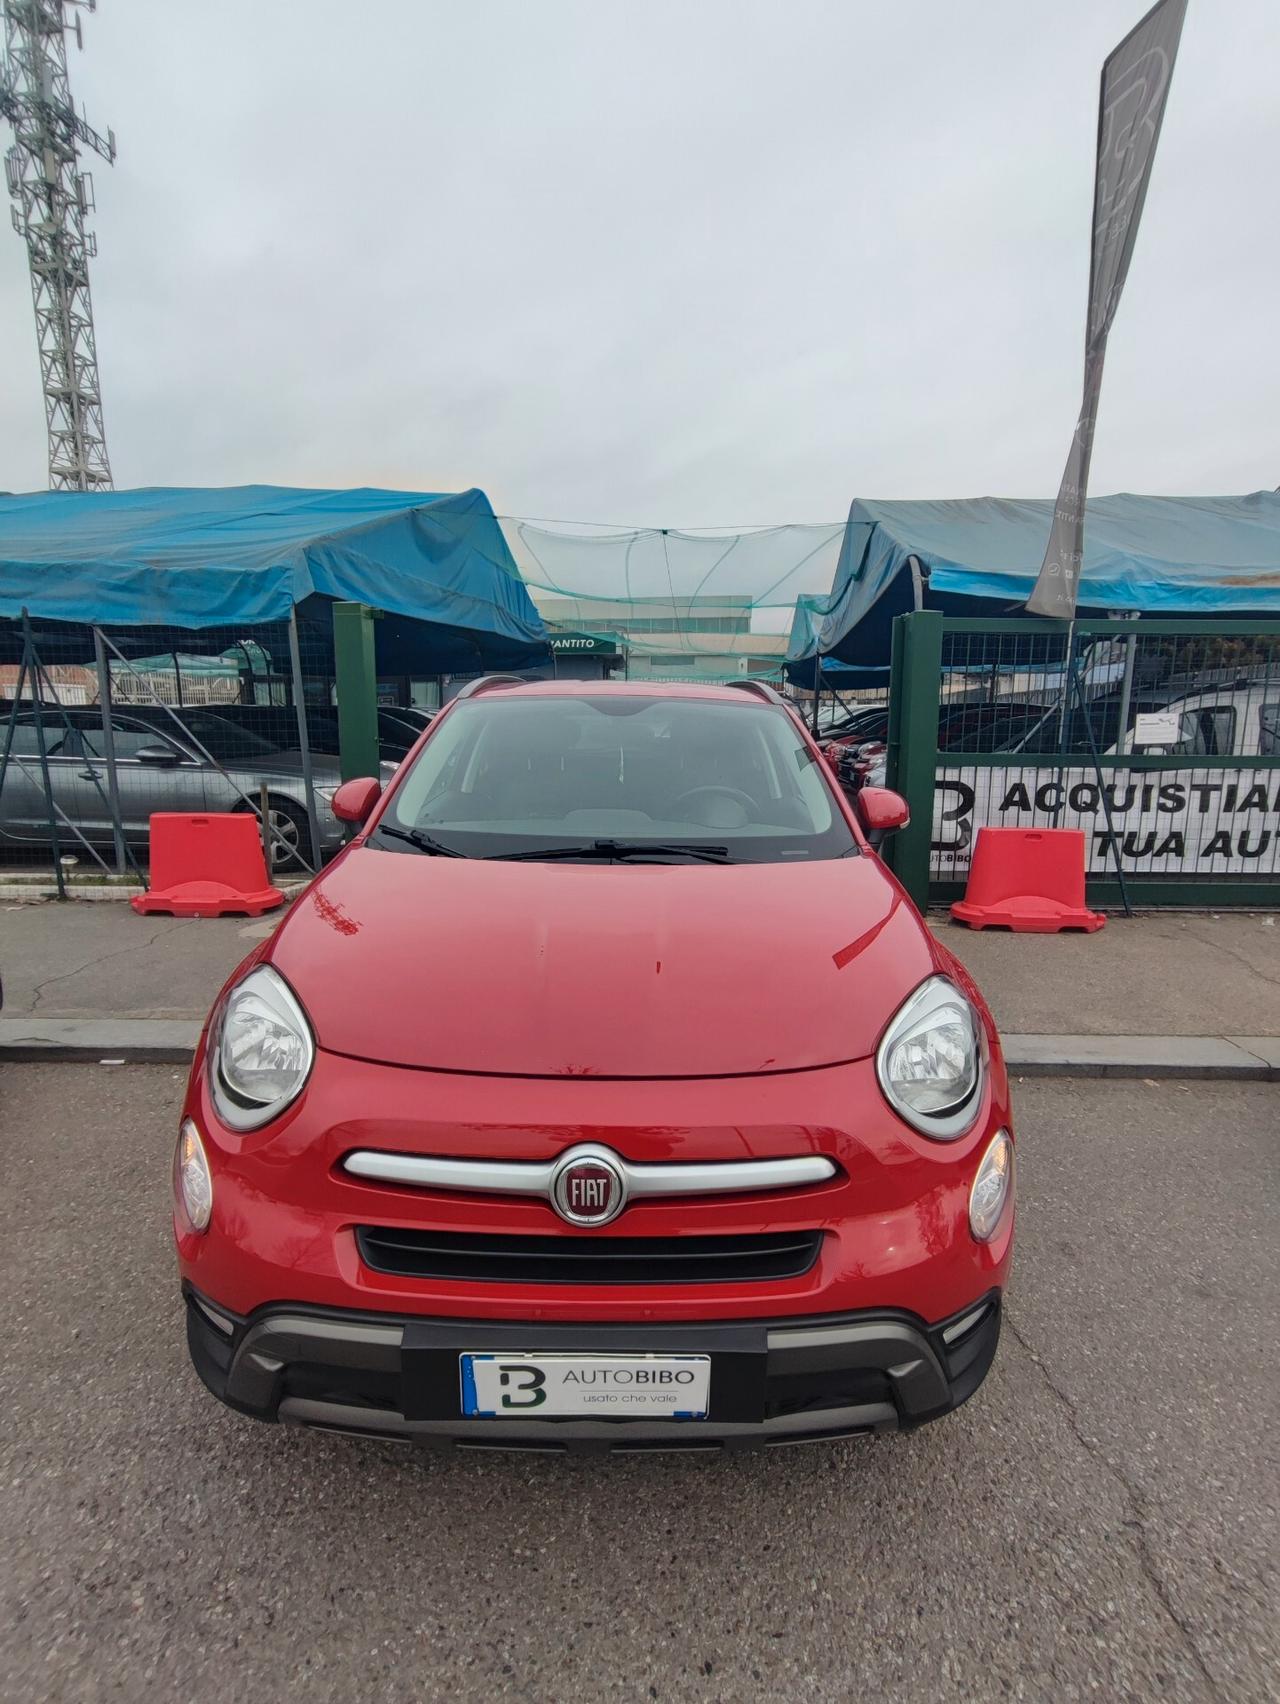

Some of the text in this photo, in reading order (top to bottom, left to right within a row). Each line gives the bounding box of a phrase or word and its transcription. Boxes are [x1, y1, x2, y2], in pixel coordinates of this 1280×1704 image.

[1092, 831, 1185, 857] TUA
[572, 1179, 607, 1206] FIAT
[562, 1370, 694, 1384] AUTOBIBO
[583, 1394, 677, 1403] usato che vale
